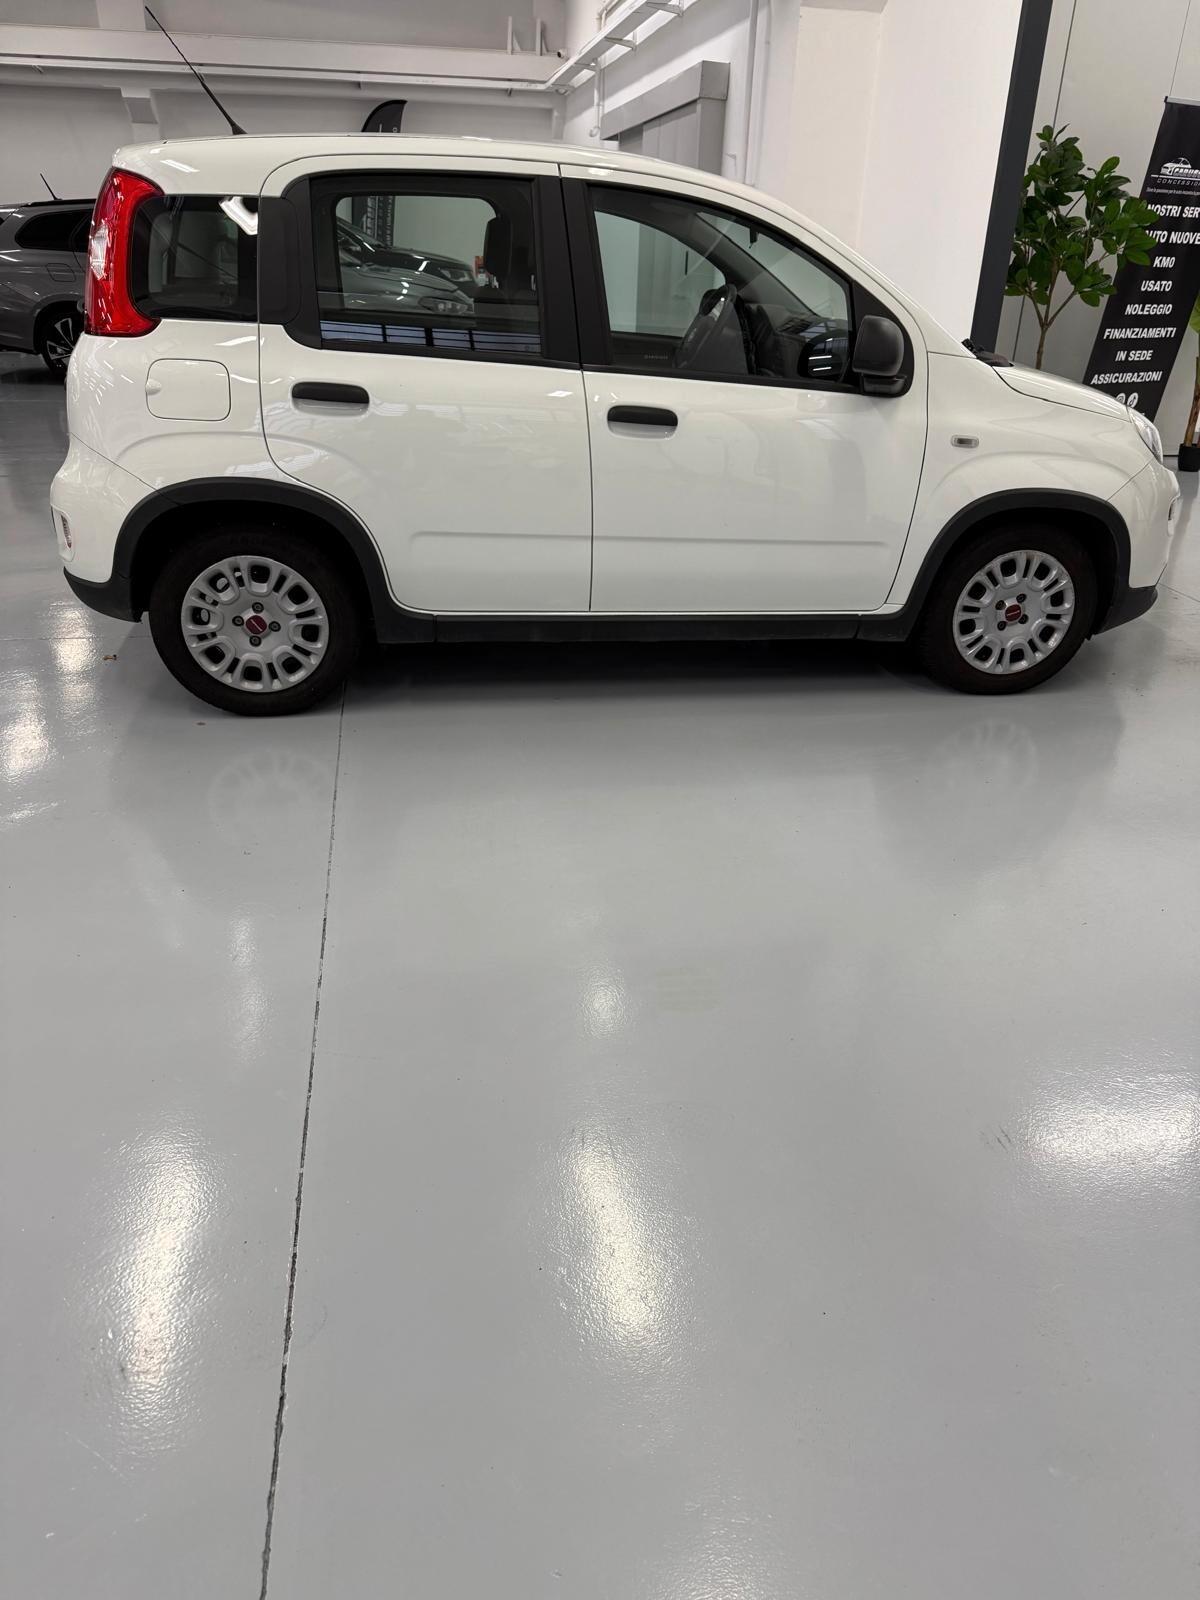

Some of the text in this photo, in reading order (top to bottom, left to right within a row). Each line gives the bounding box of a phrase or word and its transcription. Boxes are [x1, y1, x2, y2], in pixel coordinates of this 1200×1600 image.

[1157, 178, 1200, 186] CONCESSIO
[1145, 230, 1200, 245] UTO NUOVE
[1141, 280, 1173, 291] USATO
[1125, 304, 1173, 315] NOLEGGIO
[1103, 327, 1177, 339] FINANZIAMENTI
[1115, 350, 1153, 361] IN SEDE
[1091, 371, 1163, 385] ASSICURAZIONI
